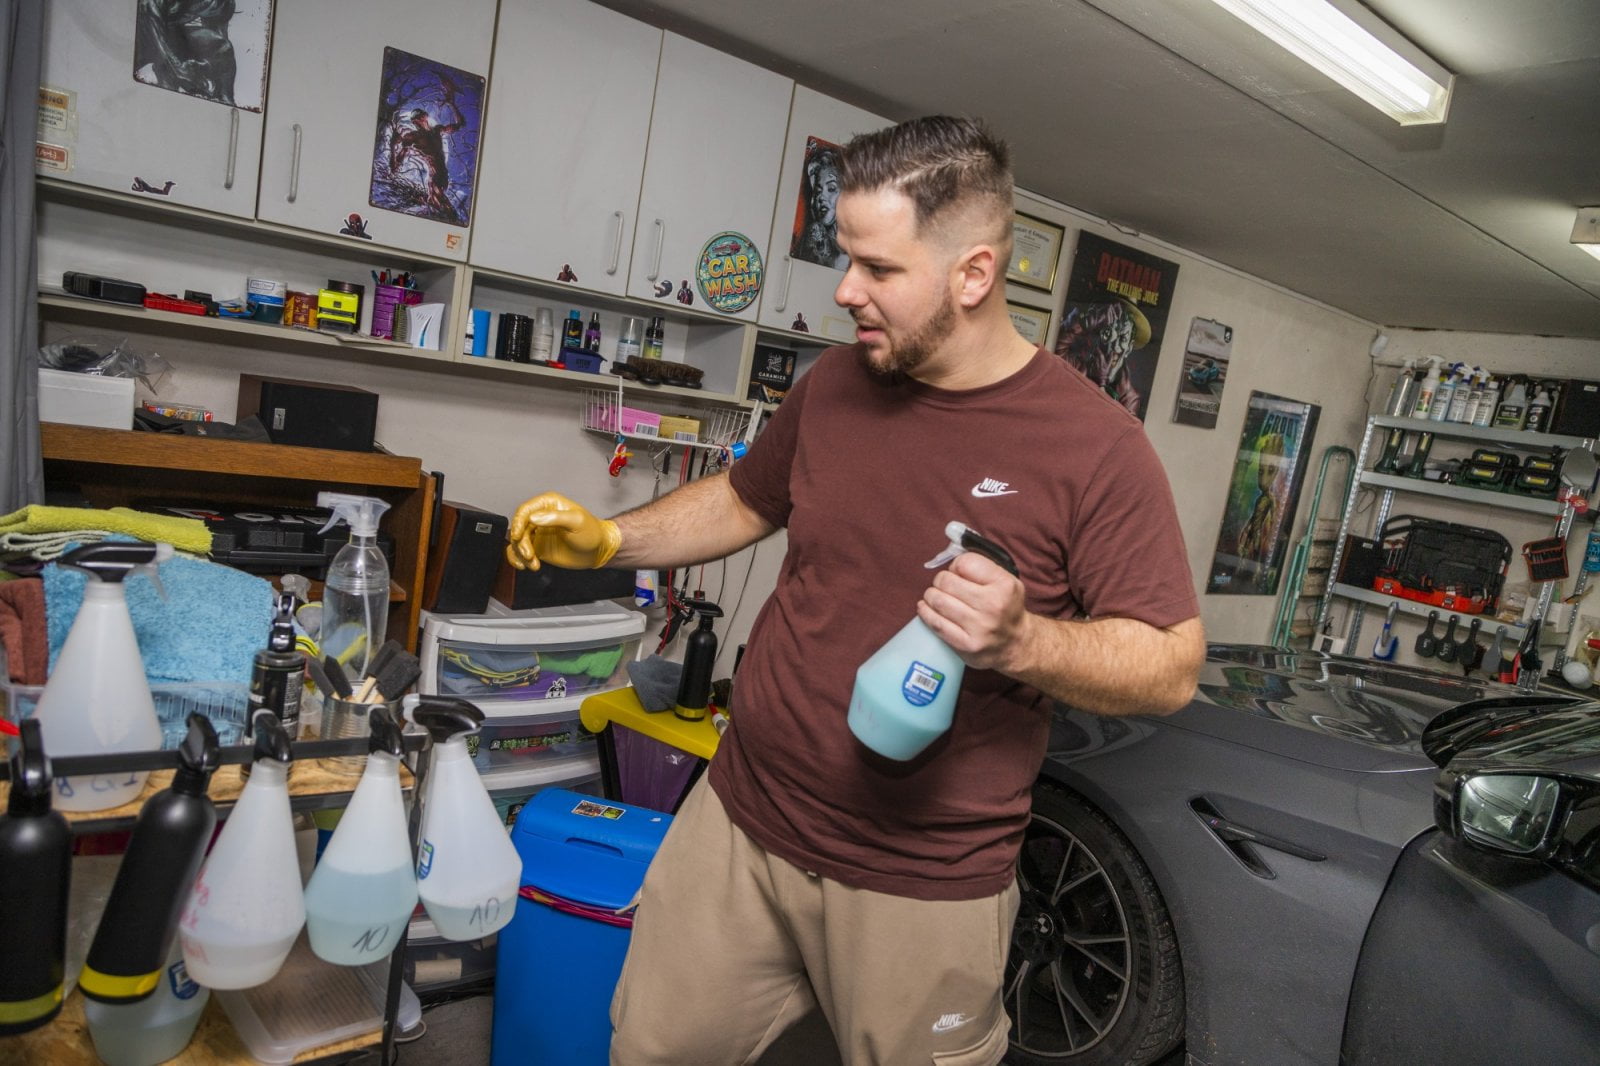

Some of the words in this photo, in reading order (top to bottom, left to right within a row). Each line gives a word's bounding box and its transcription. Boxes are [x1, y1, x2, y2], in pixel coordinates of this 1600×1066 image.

[708, 254, 750, 278] CAR
[1097, 251, 1160, 293] BATMAN
[704, 273, 758, 298] WASH
[1107, 277, 1119, 294] THE
[1119, 281, 1143, 301] KILLING
[1142, 290, 1159, 306] JOKE
[1262, 412, 1301, 438] GROOT
[980, 477, 1009, 494] NIKE
[469, 897, 500, 934] 10
[352, 925, 390, 954] 10
[938, 1012, 966, 1028] NIKE
